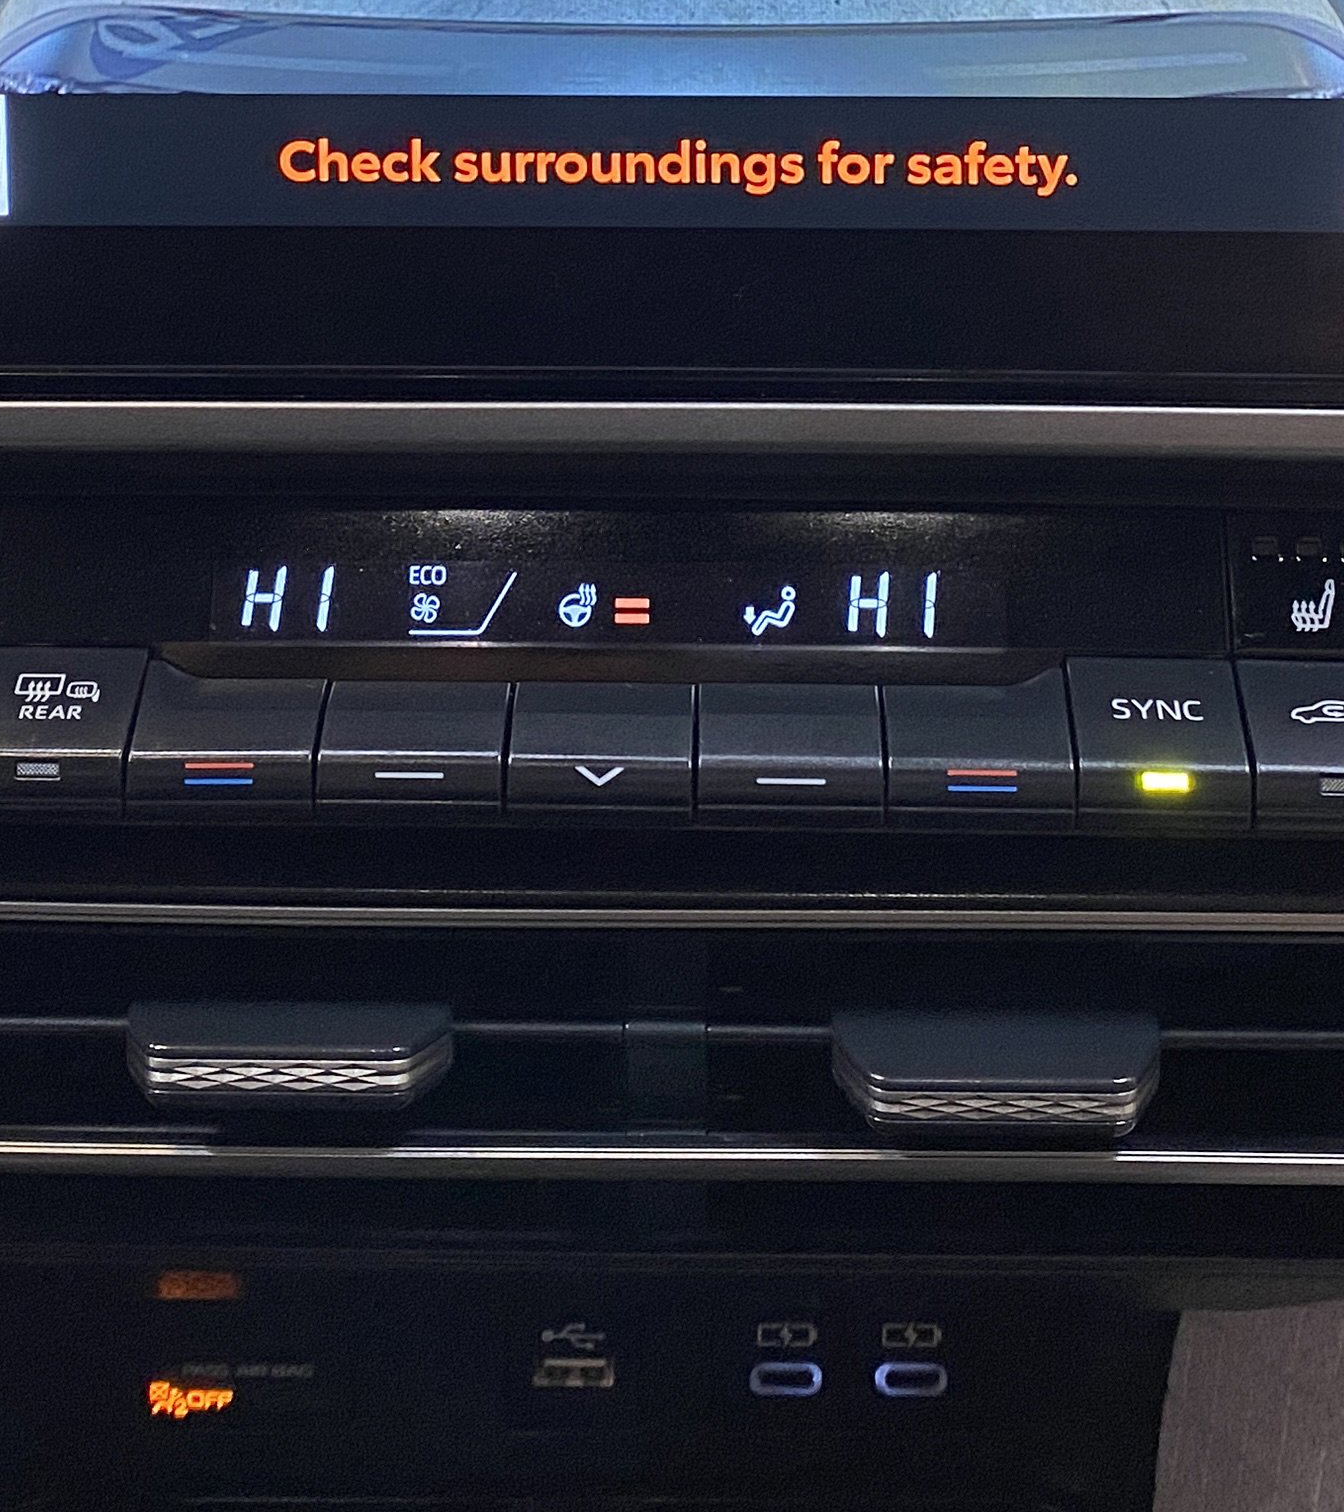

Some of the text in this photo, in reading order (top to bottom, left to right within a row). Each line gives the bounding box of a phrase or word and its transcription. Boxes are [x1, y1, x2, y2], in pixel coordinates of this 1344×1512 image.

[278, 137, 1078, 198] Check surroundings for safety.
[408, 565, 448, 586] ECO
[240, 564, 336, 633] HI
[846, 569, 941, 639] HI
[17, 703, 83, 721] REAR
[1111, 698, 1205, 723] SYNC
